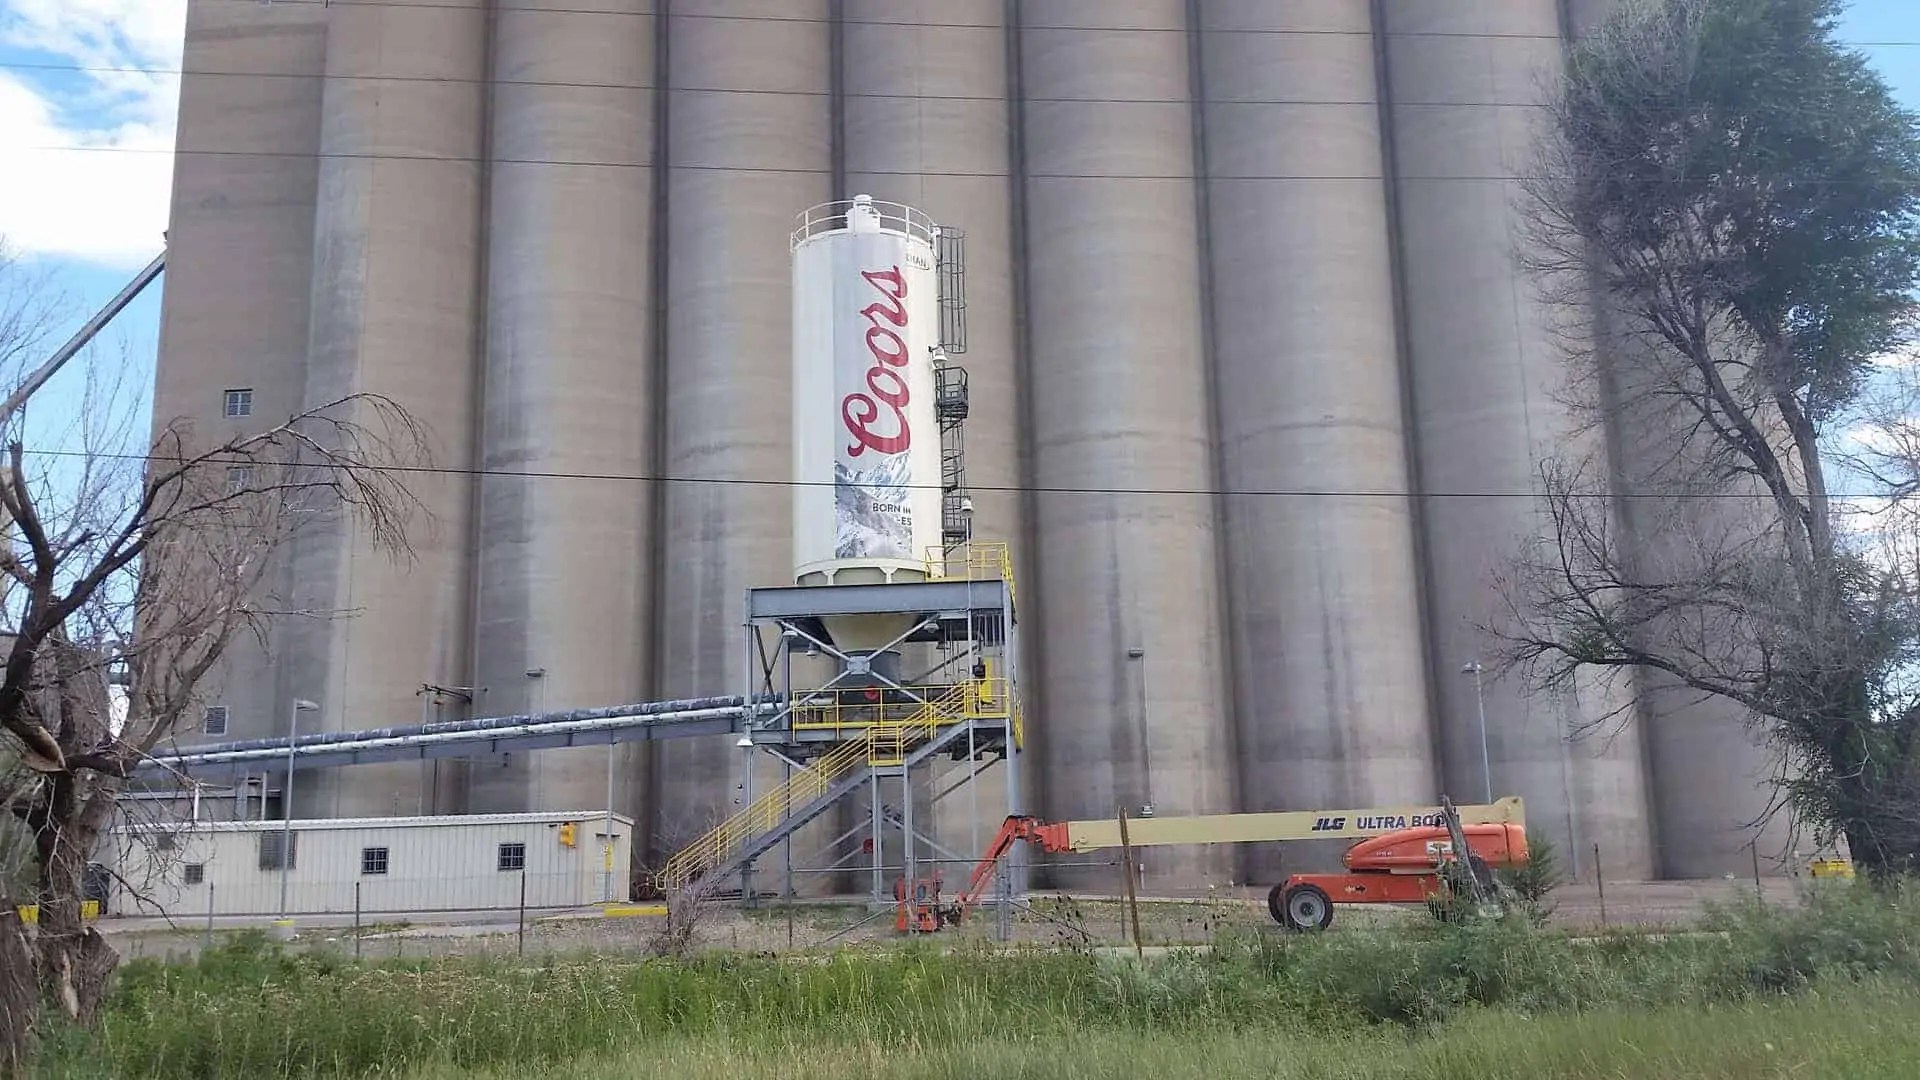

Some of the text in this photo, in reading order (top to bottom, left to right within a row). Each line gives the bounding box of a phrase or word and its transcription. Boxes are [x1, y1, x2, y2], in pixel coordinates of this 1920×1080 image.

[842, 265, 911, 457] Coors
[872, 503, 900, 513] BORN
[1311, 817, 1346, 831] JLG
[1356, 816, 1406, 830] ULTRA
